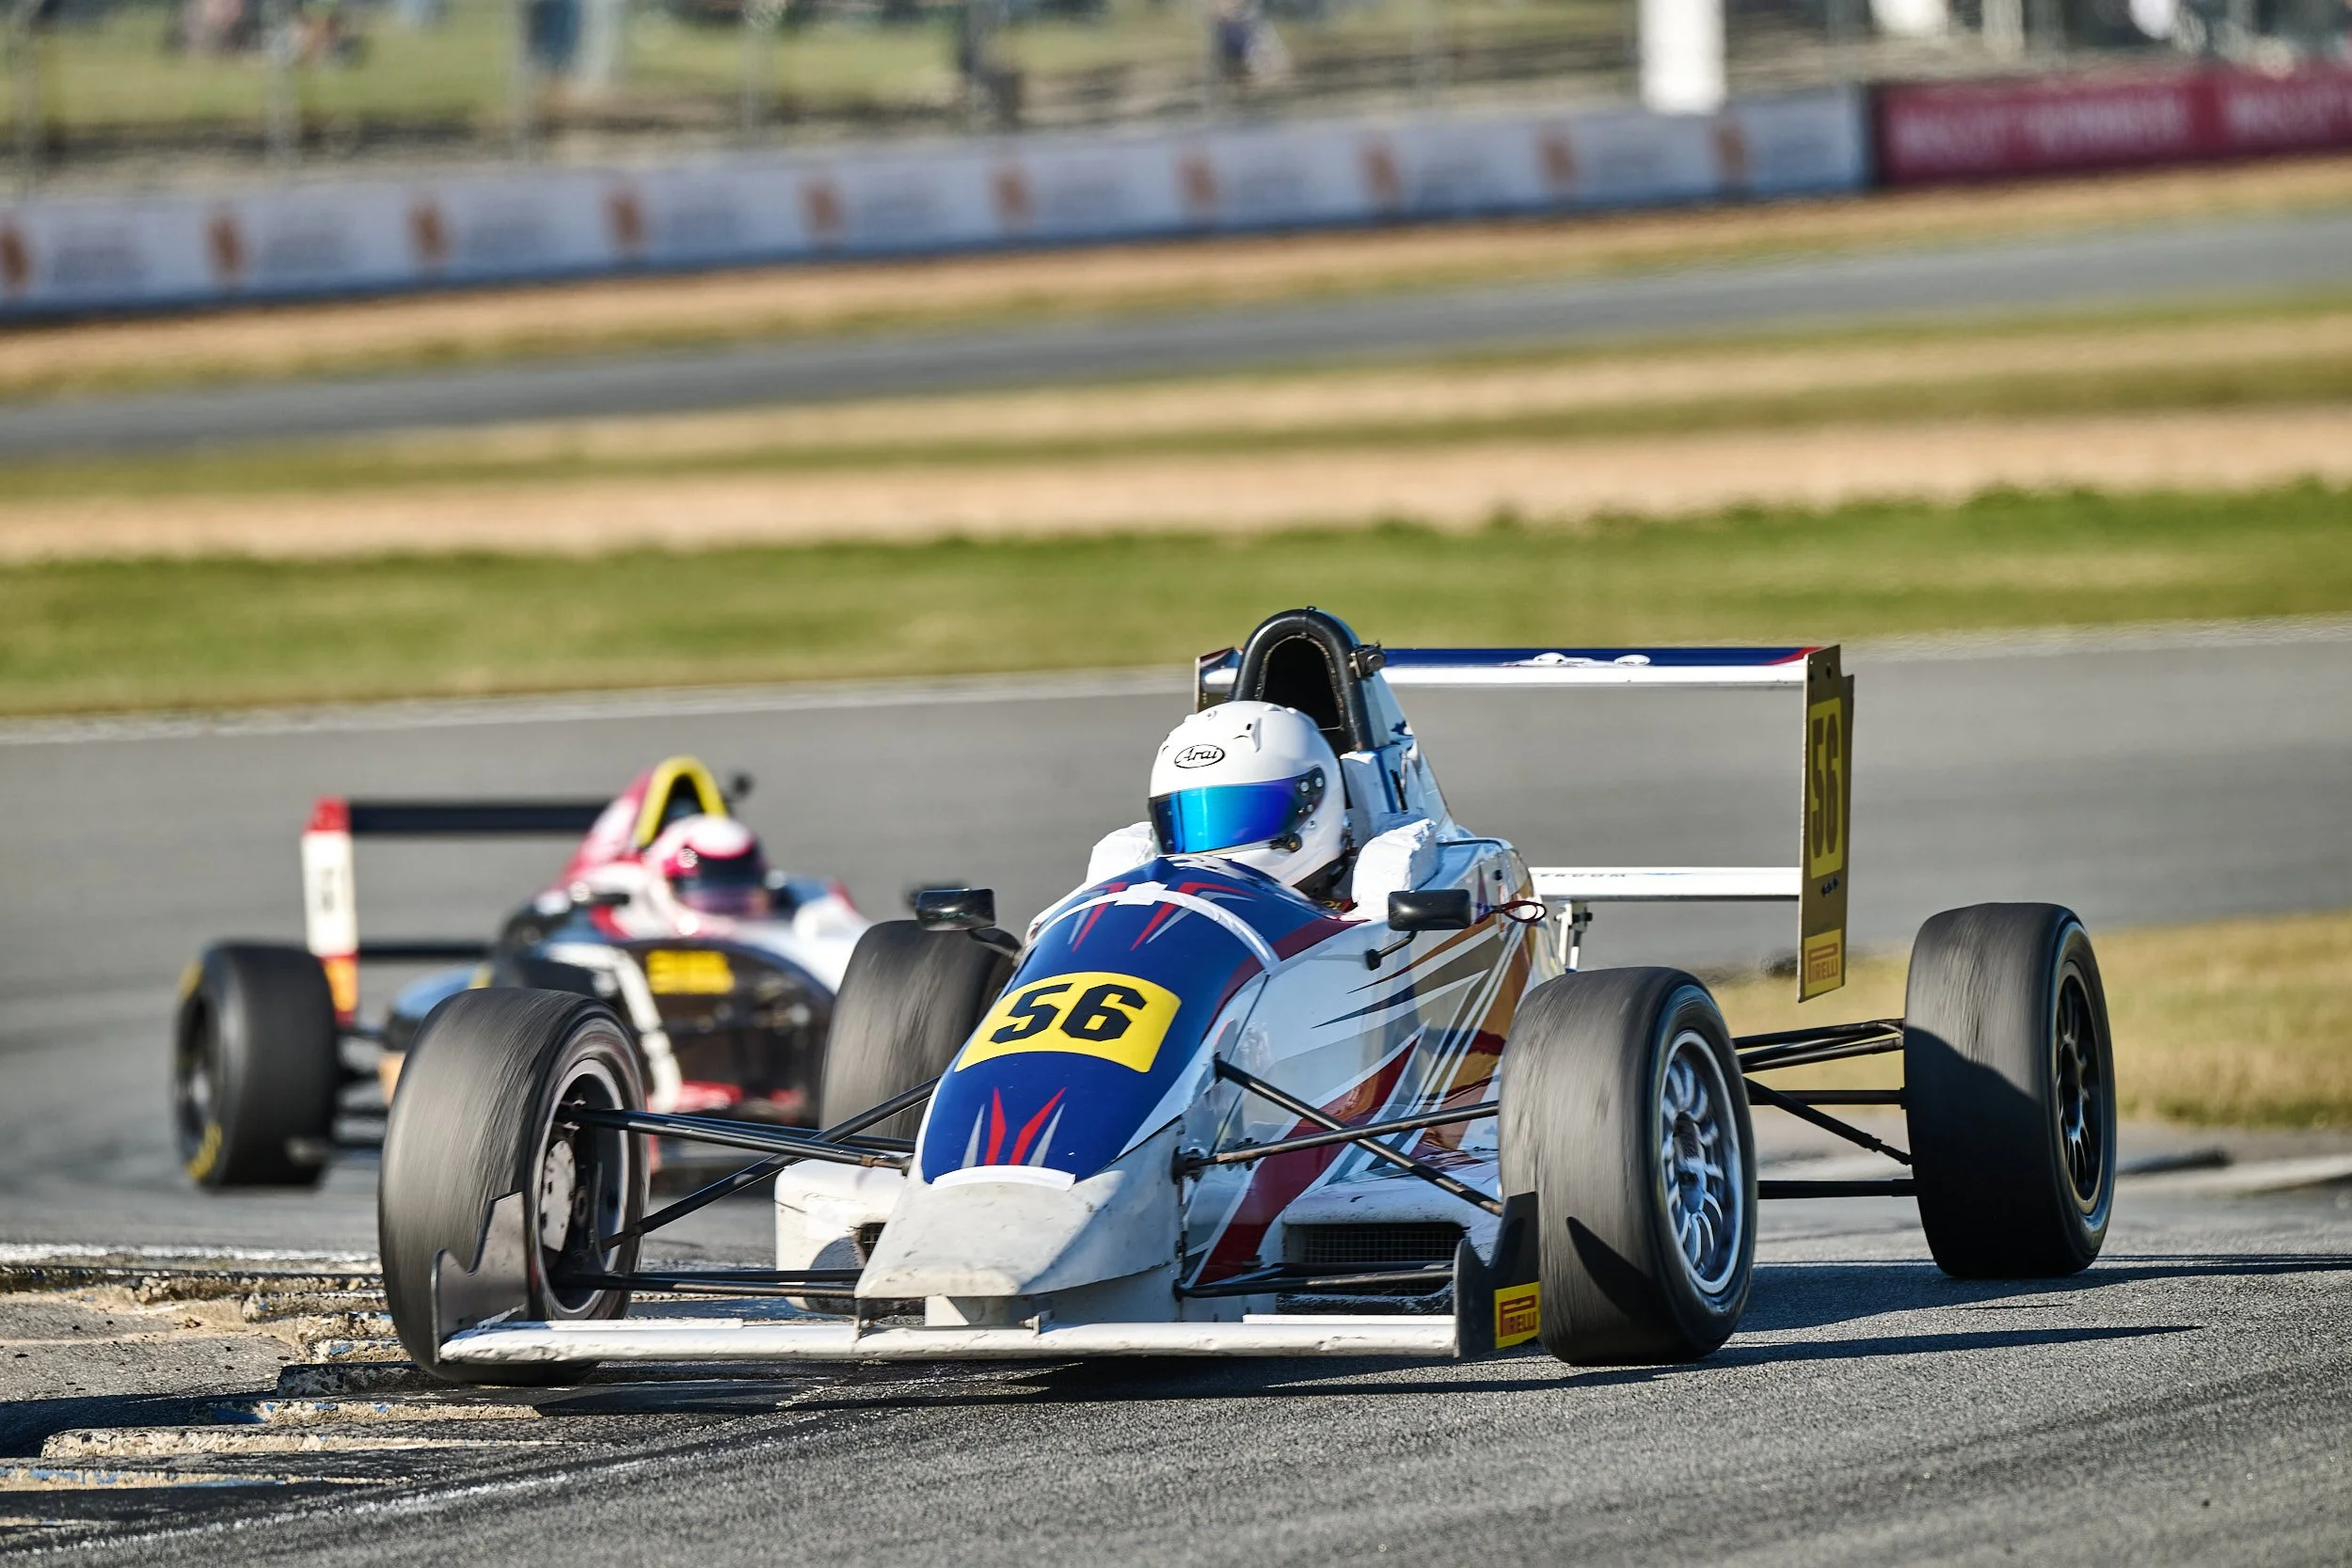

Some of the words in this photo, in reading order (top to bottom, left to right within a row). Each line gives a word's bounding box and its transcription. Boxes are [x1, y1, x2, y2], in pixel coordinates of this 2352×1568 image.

[1811, 712, 1839, 860] 56
[1807, 942, 1838, 984] PIRELLI
[989, 982, 1148, 1045] 56
[1500, 1294, 1536, 1338] PIRELLI
